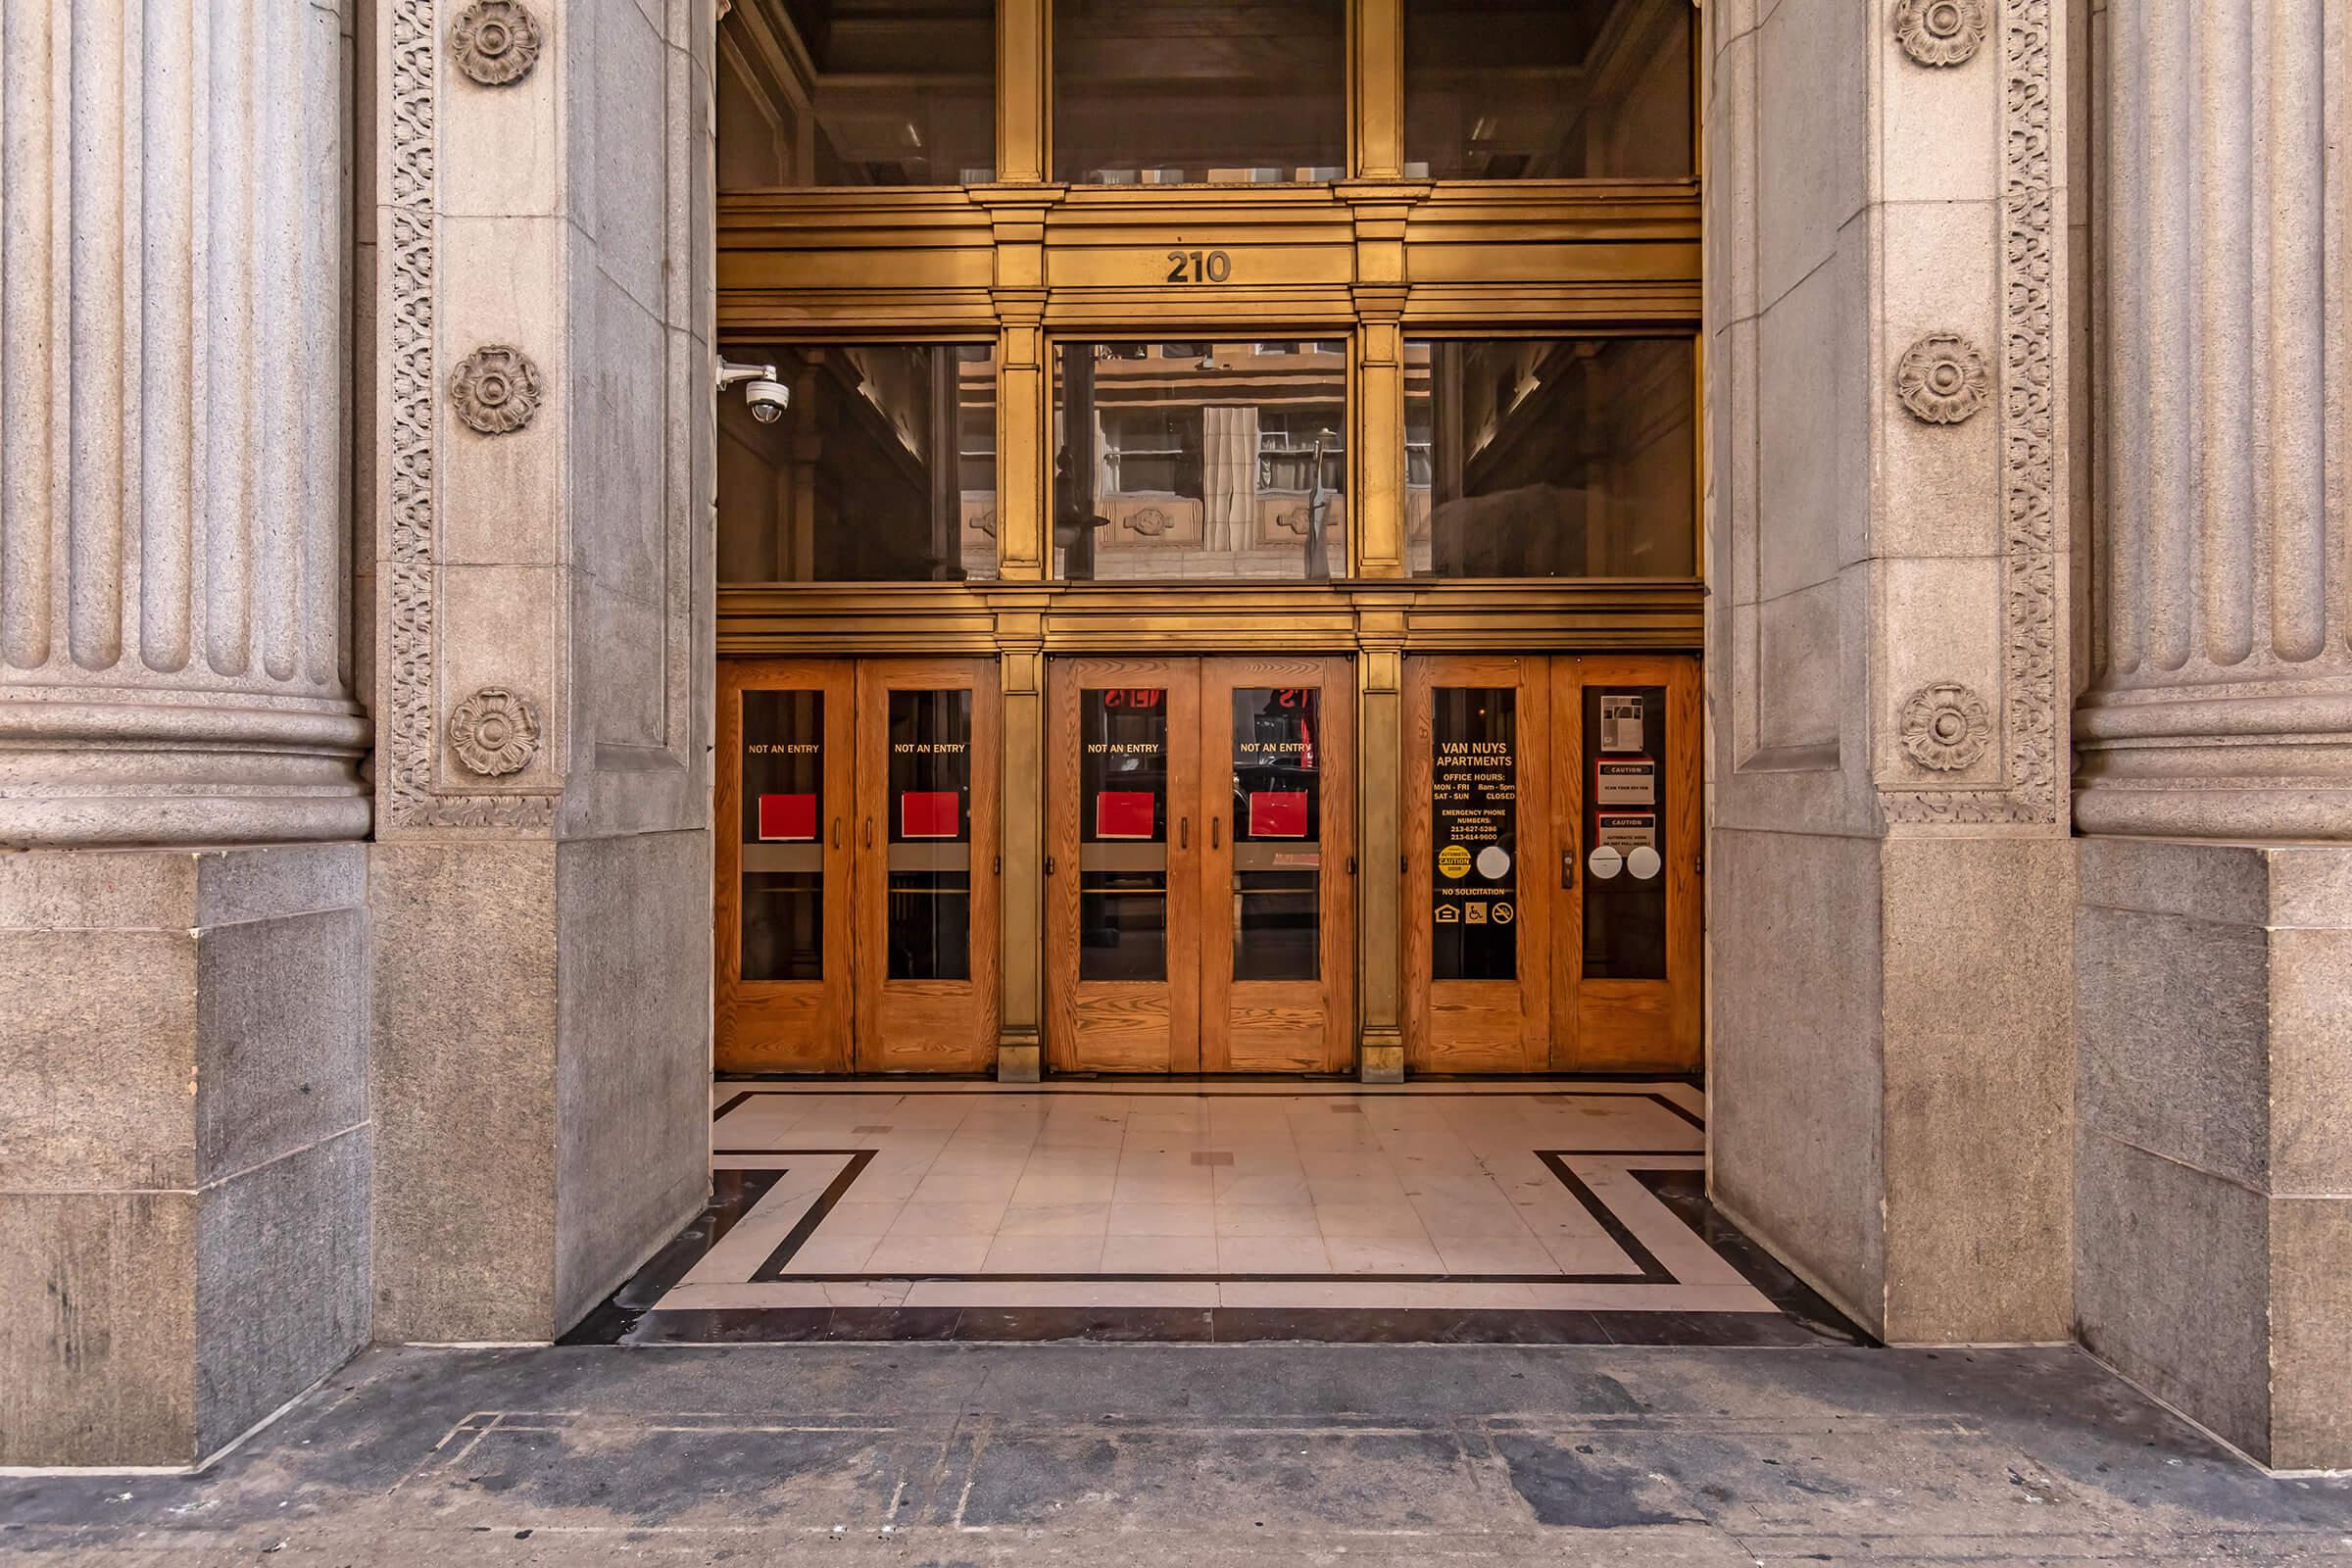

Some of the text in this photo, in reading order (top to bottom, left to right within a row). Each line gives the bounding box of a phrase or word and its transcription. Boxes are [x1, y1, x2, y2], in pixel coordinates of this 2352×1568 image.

[1167, 250, 1232, 283] 210
[749, 744, 819, 754] NOT AN ENTRY
[895, 744, 965, 754] NOT AN ENTRY
[1088, 744, 1159, 754] NOT AN ENTRY
[1240, 743, 1312, 753] NOT AN ENTRY
[1442, 743, 1507, 754] VAN NUYS
[1437, 757, 1513, 766] APARTMENTS
